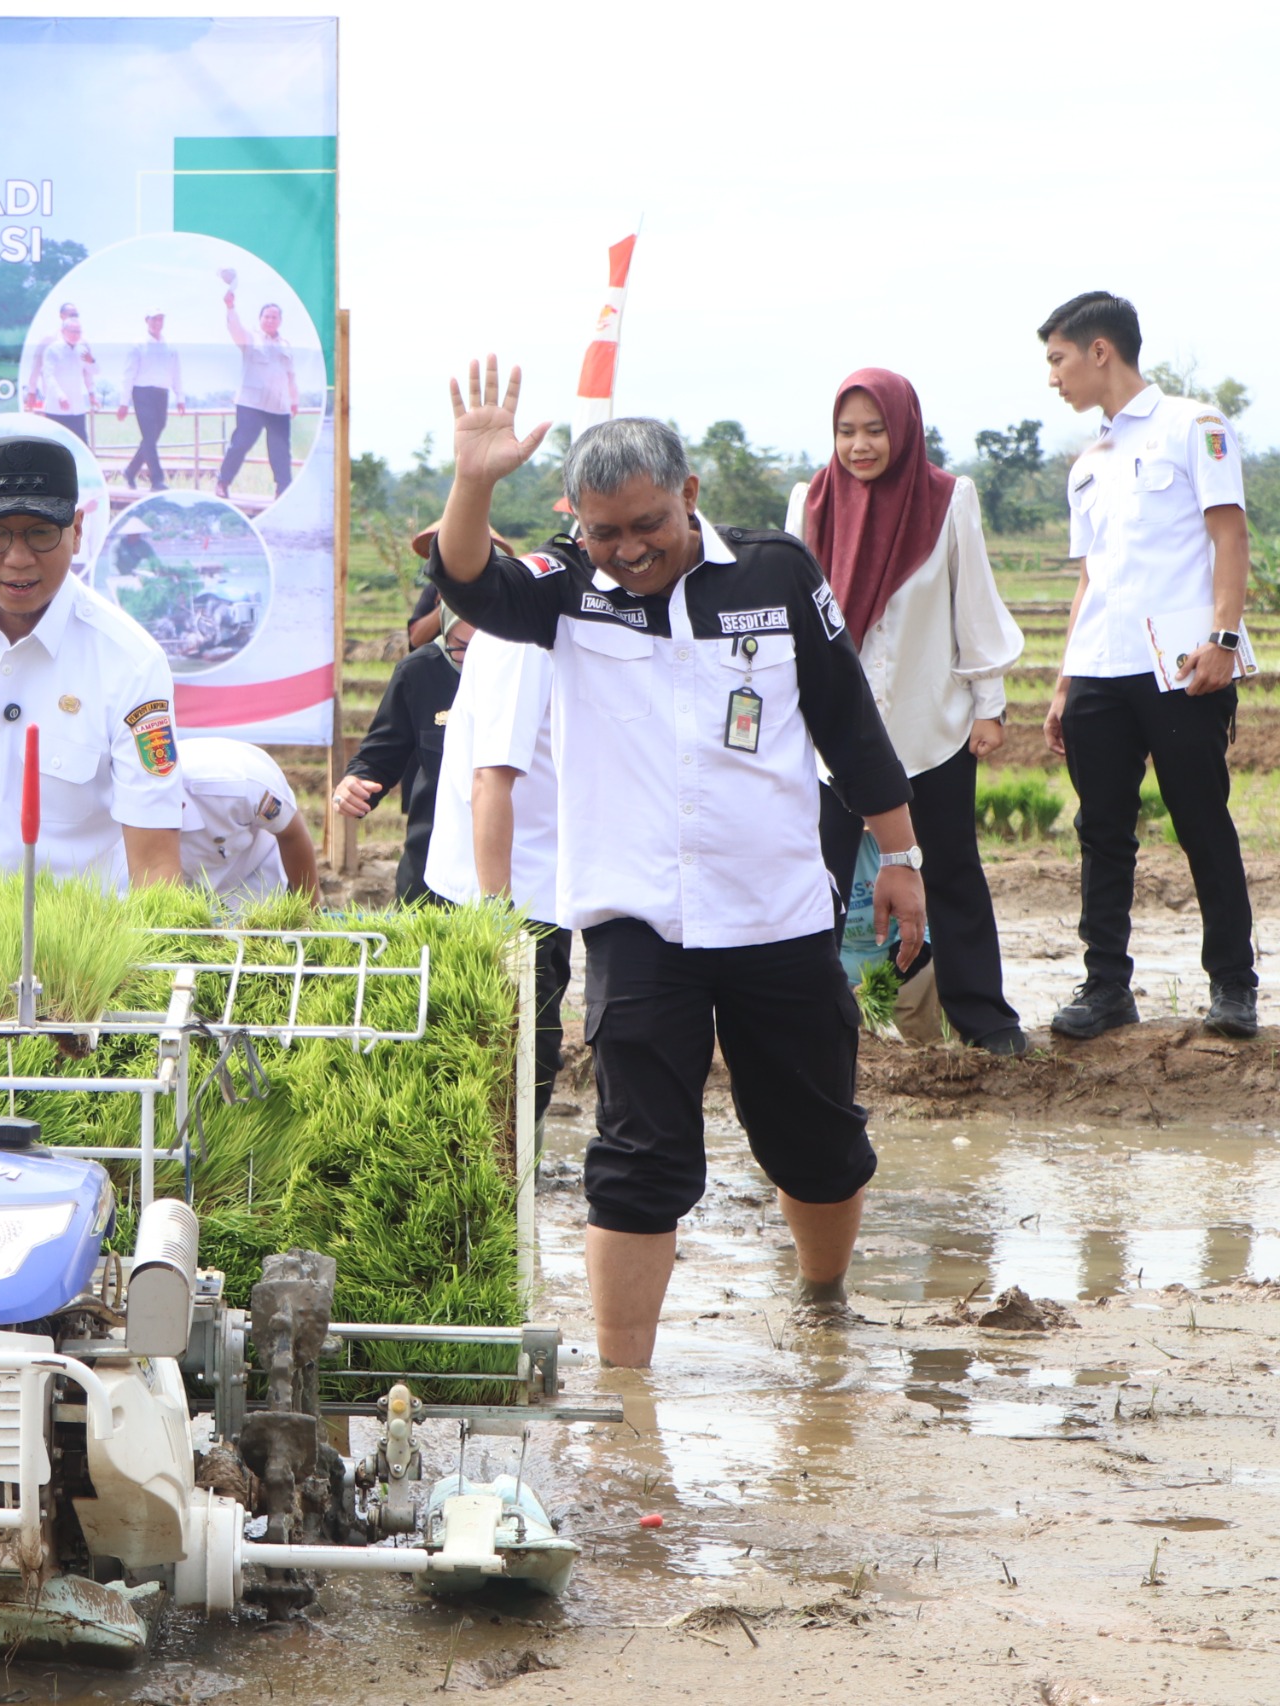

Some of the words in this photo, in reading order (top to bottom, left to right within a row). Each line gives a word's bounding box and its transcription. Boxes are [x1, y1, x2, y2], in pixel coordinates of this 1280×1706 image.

[614, 609, 644, 624] ATULE
[723, 611, 786, 630] SESDITJEN
[135, 718, 169, 733] LAMPUNG
